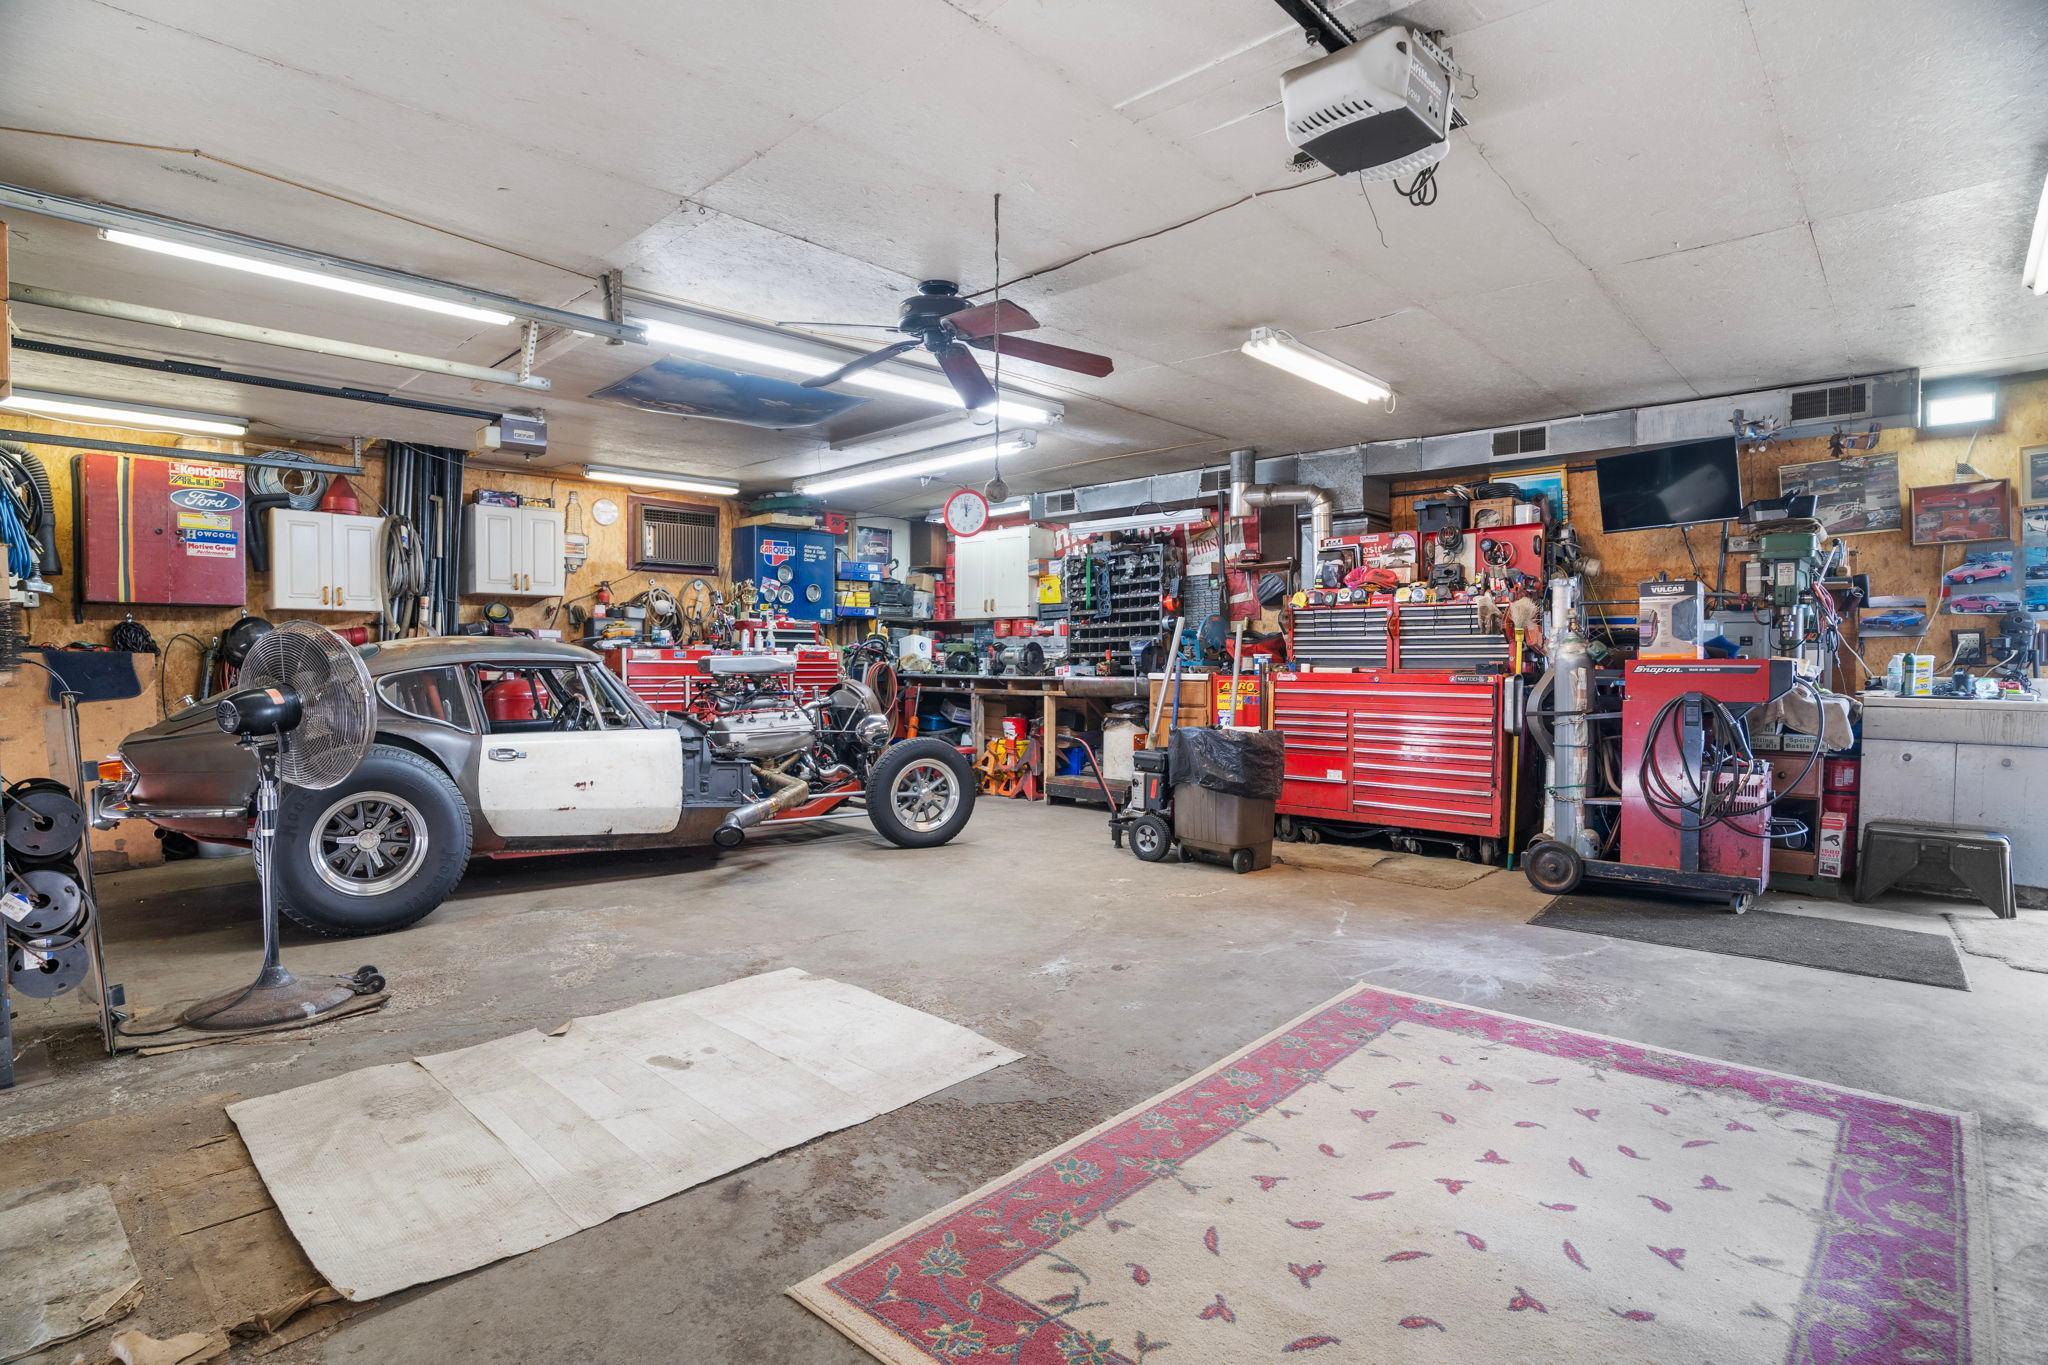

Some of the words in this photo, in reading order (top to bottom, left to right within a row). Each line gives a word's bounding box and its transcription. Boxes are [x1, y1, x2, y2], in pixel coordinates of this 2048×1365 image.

[179, 464, 228, 478] Kendall
[184, 490, 228, 508] Ford
[214, 544, 235, 552] Gear
[760, 545, 795, 555] CARQUEST
[1650, 585, 1685, 593] VULCAN
[1634, 665, 1681, 675] Snap-on
[1221, 681, 1255, 692] ARO
